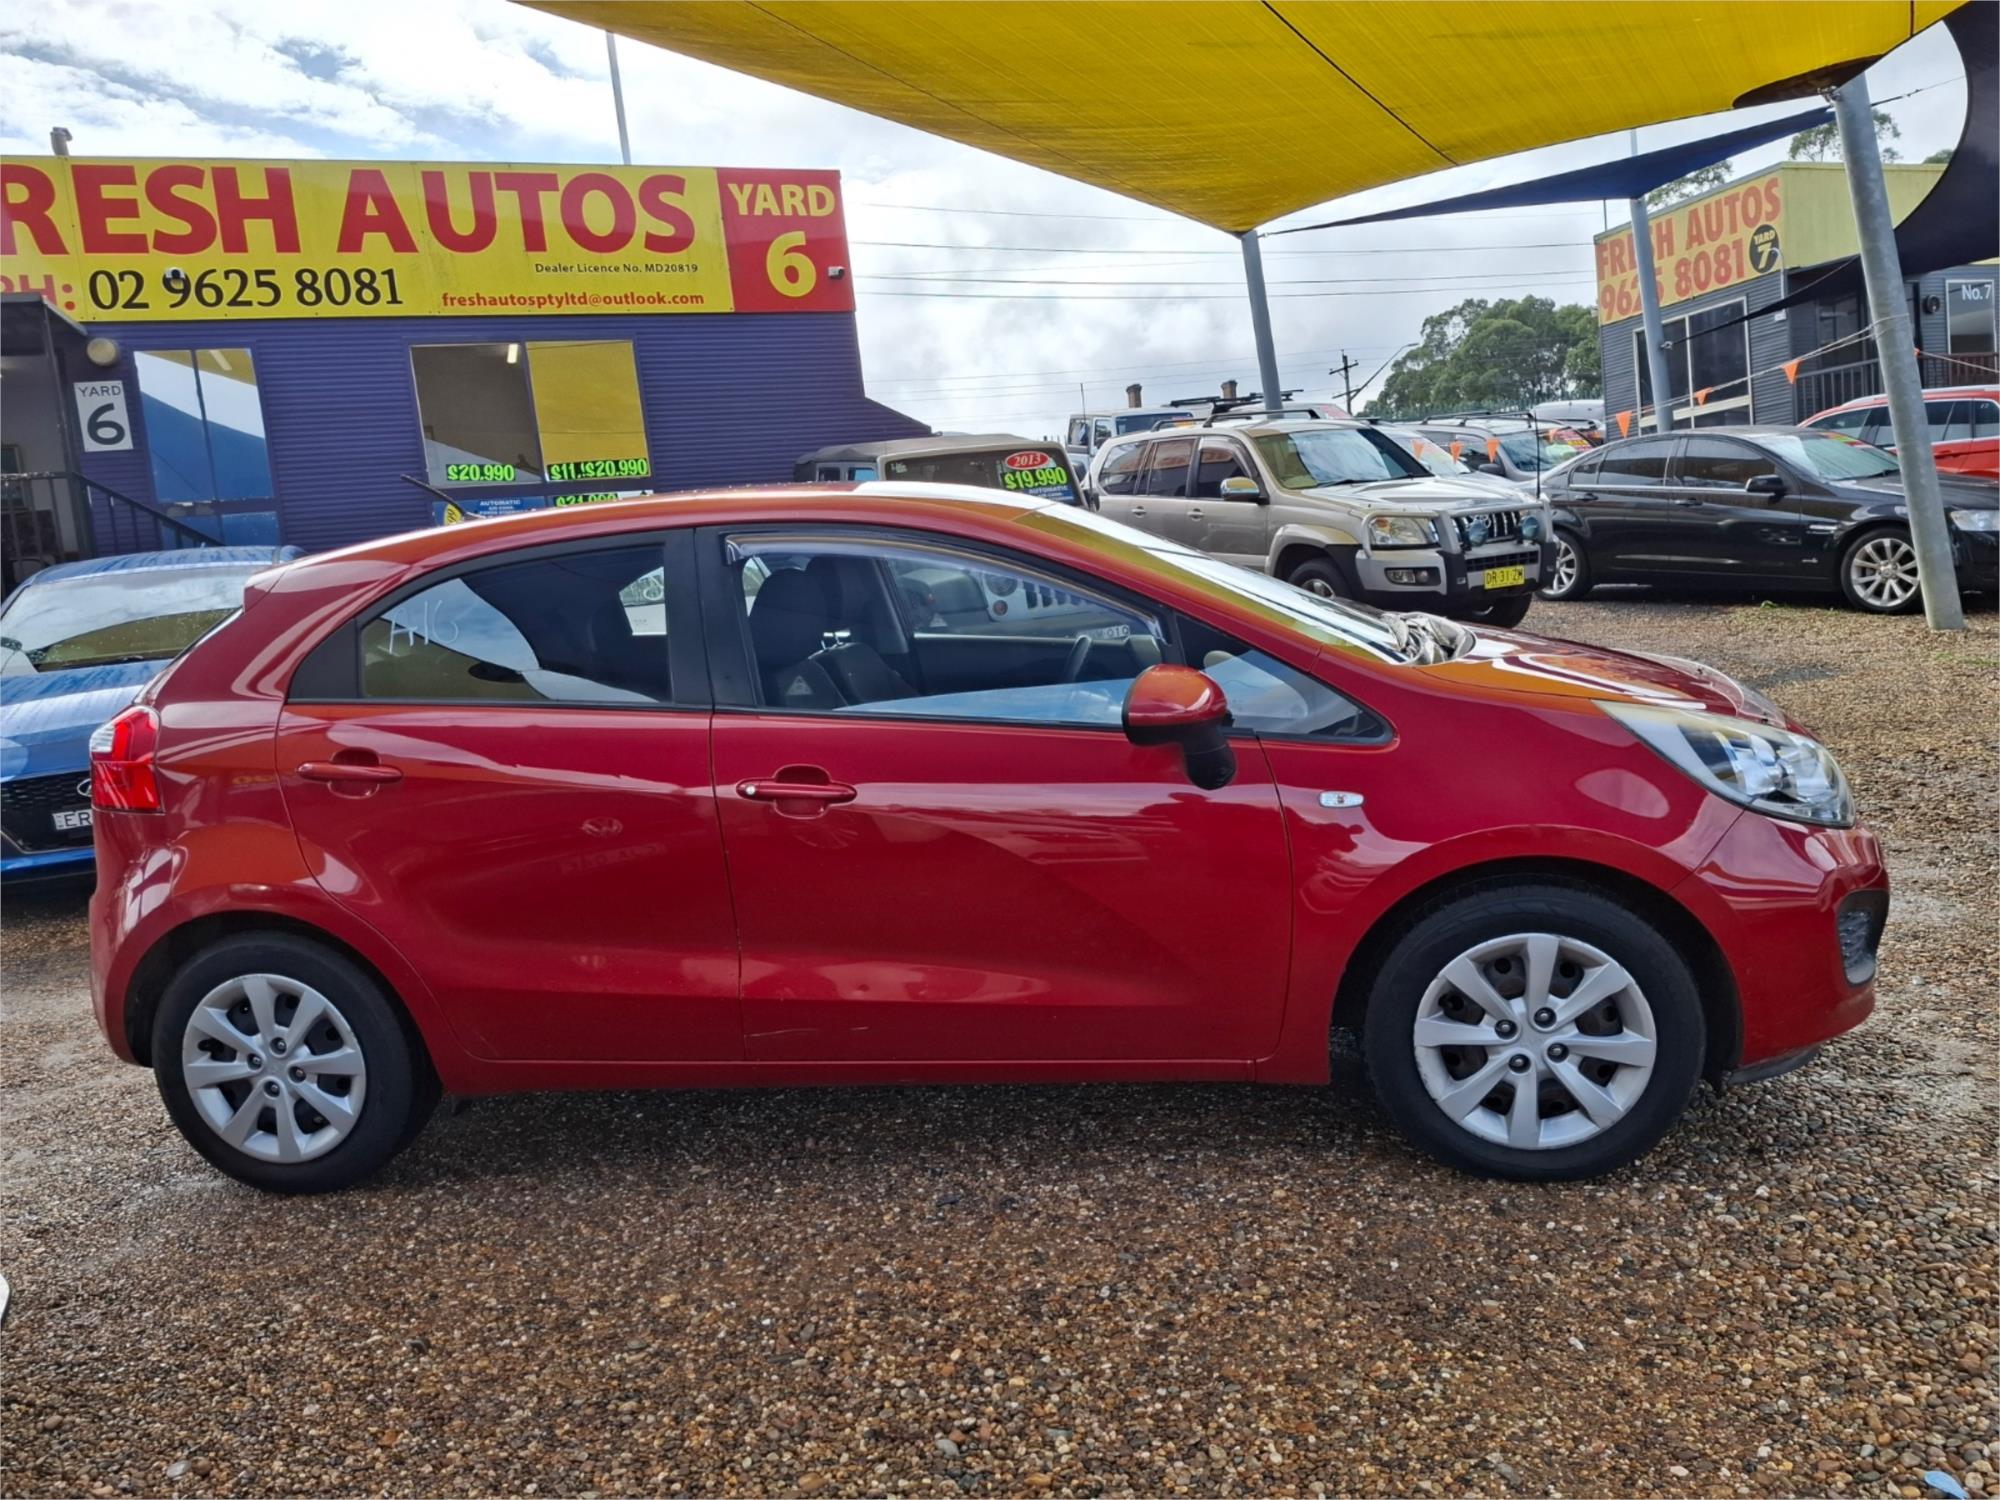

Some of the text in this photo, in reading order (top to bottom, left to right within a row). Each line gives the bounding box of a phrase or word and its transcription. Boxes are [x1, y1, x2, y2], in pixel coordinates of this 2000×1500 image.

[337, 169, 696, 254] AUTOS
[727, 183, 835, 216] YARD
[1686, 177, 1781, 251] AUTOS
[1753, 229, 1776, 246] YARD
[535, 263, 698, 273] Dealer Licence No. MD20819
[766, 231, 817, 297] 6
[1674, 238, 1744, 298] 8081
[1758, 241, 1773, 269] 7
[88, 269, 150, 310] 02
[162, 268, 282, 308] 9625
[294, 268, 403, 306] 8081
[442, 291, 704, 309] freshautosptyltd@outlook.com
[78, 385, 121, 397] YARD
[87, 402, 125, 446] 6
[447, 464, 515, 481] $20.990
[585, 459, 648, 478] $20.990
[1014, 453, 1041, 467] 2013
[1004, 466, 1067, 490] $19.990
